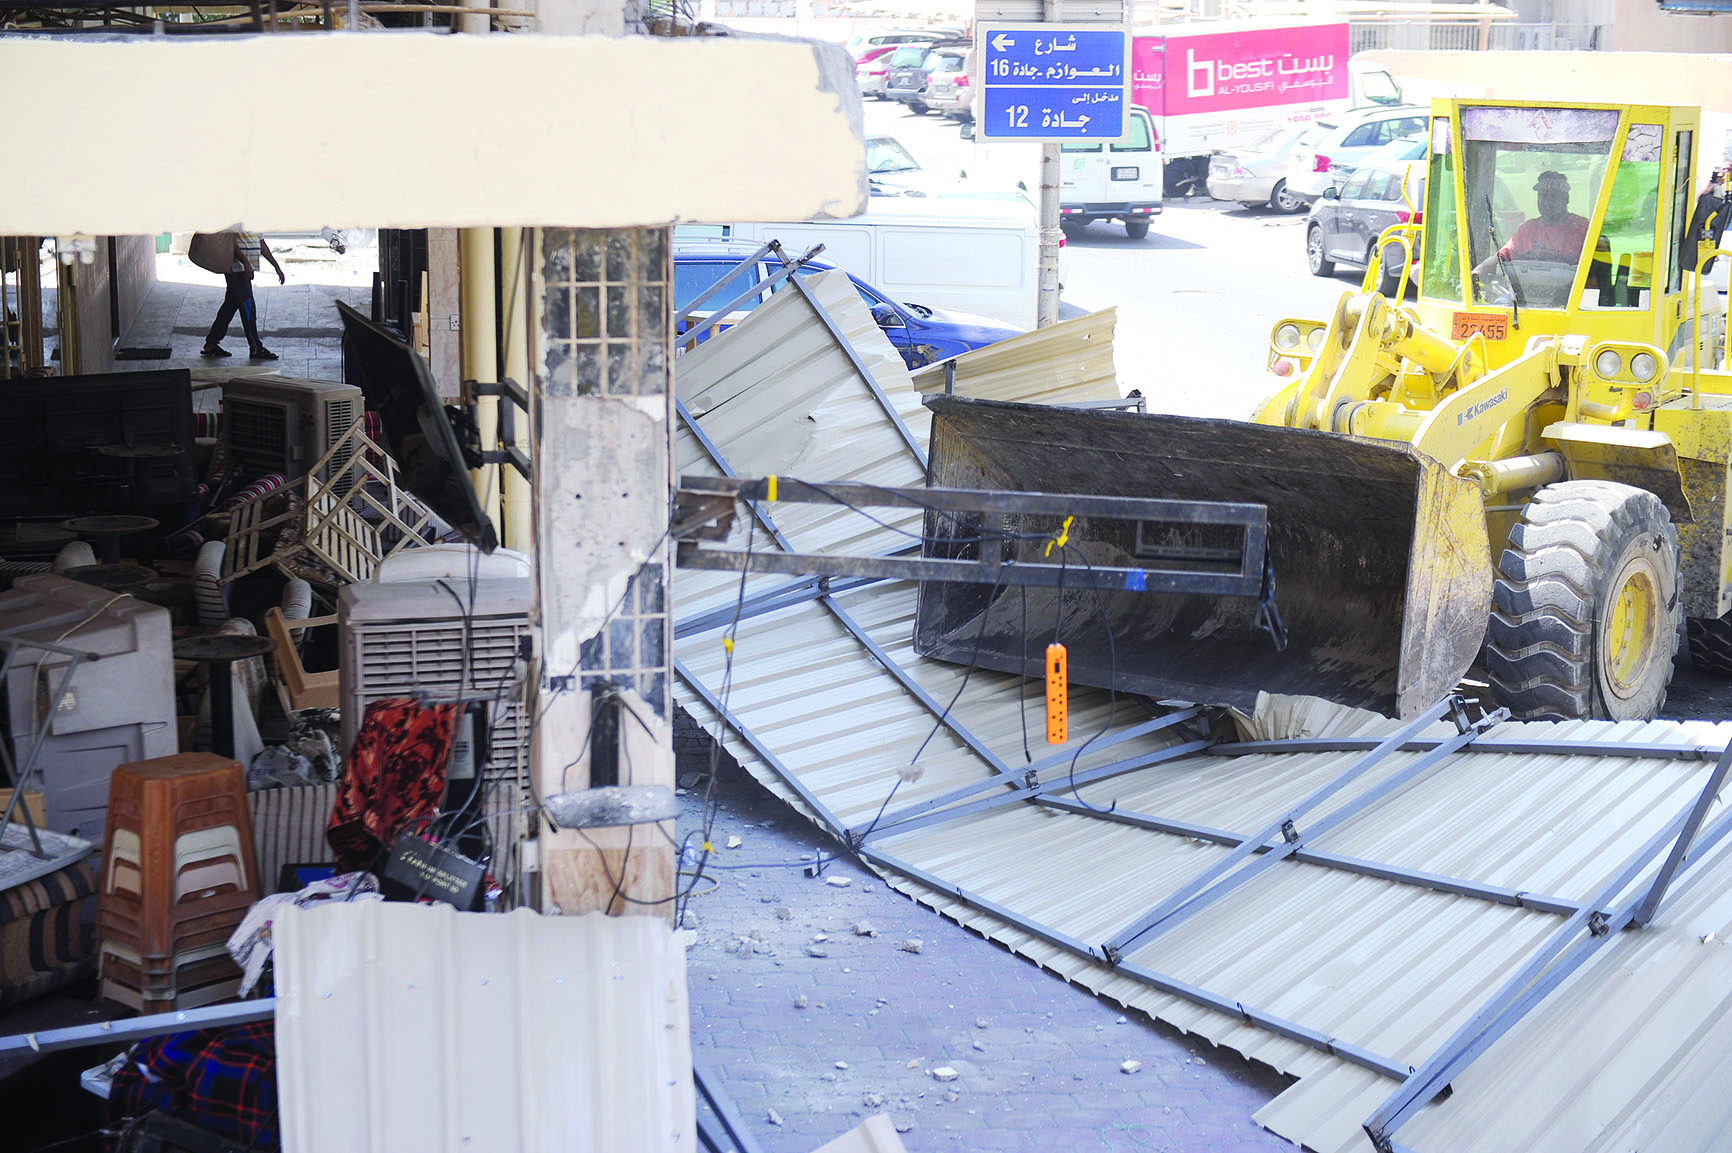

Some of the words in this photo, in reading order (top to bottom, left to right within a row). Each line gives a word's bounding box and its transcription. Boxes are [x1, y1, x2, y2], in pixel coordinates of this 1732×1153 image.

[1034, 34, 1077, 55] شارع
[990, 59, 1010, 76] 16
[1046, 62, 1120, 79] العوازم
[1217, 58, 1274, 81] best
[1277, 53, 1334, 75] بست
[1091, 92, 1119, 103] مدخل
[1005, 105, 1029, 128] 12
[1041, 107, 1091, 133] جادة
[1474, 386, 1508, 416] Kawasaki
